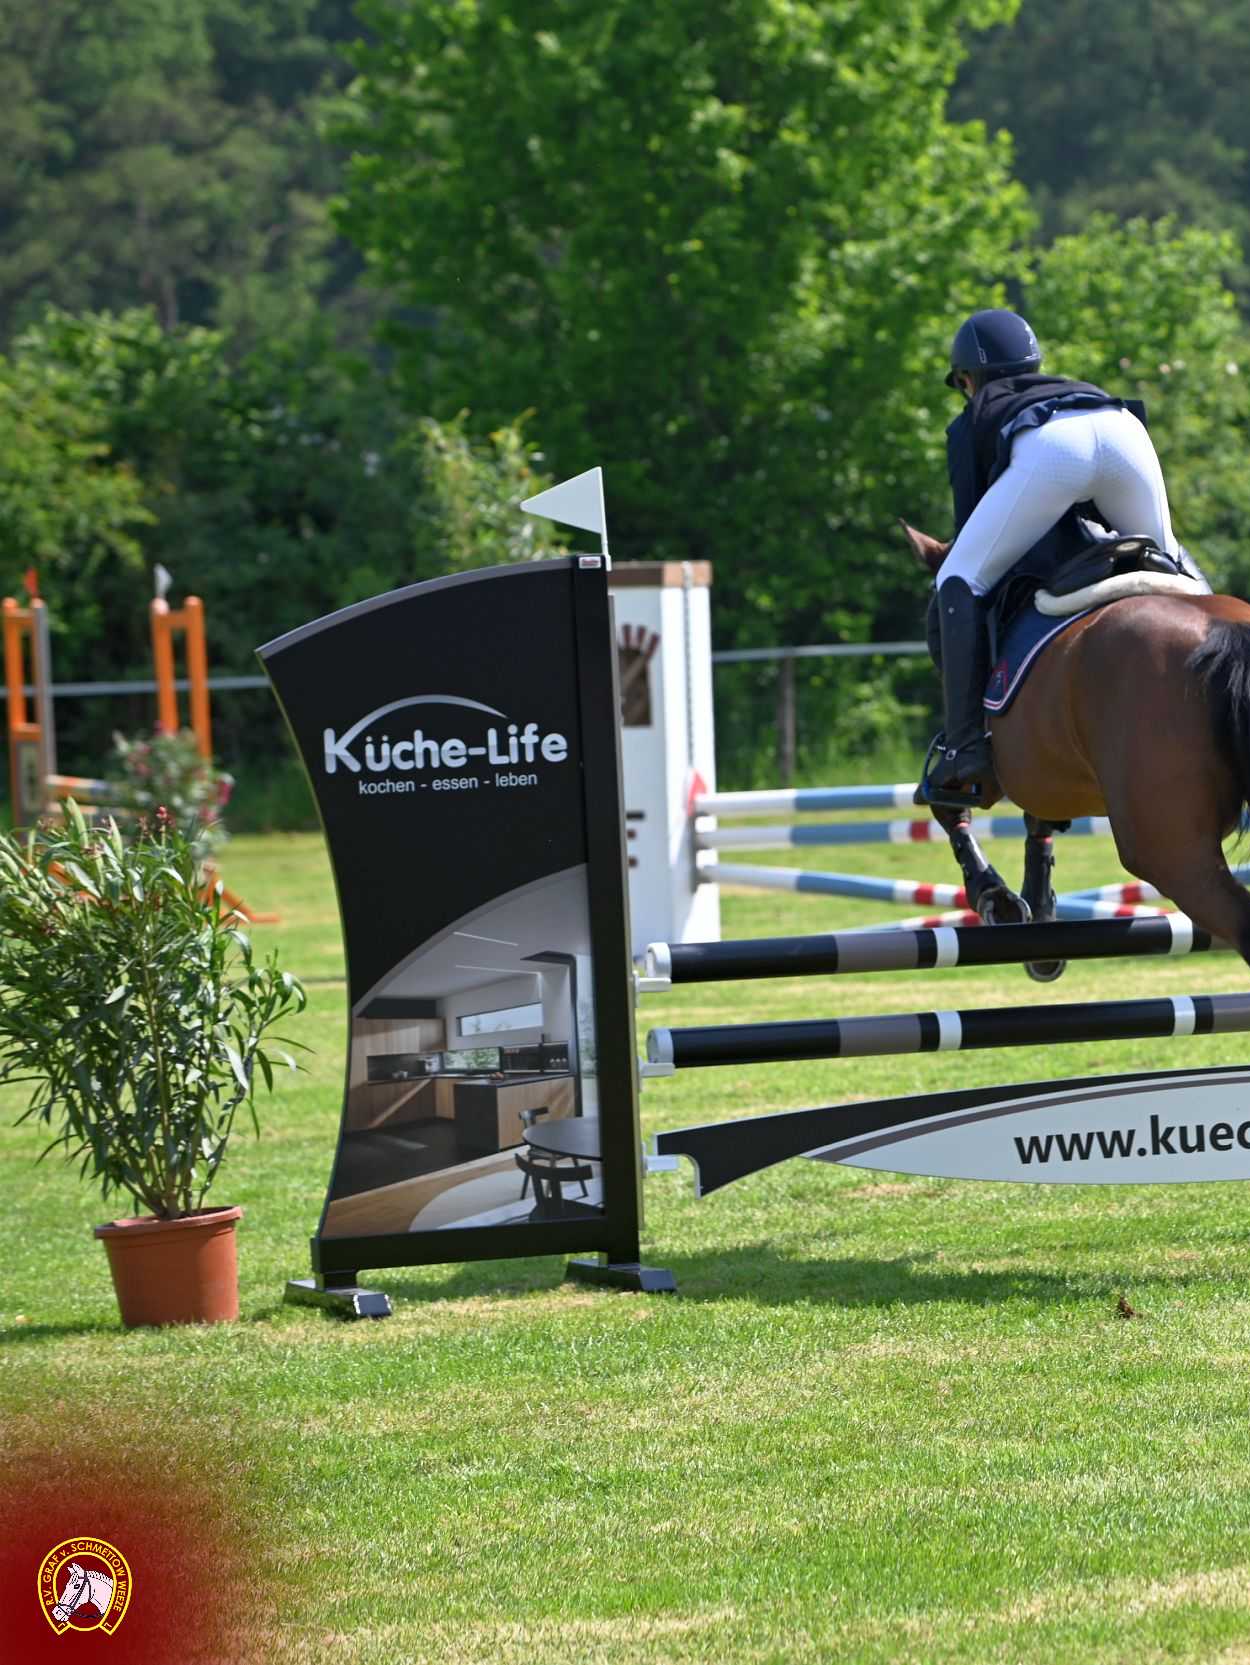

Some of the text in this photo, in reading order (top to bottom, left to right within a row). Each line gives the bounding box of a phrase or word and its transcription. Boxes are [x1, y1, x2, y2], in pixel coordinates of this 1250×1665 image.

[323, 723, 568, 774] Küche-Life
[358, 778, 415, 795] kochen
[432, 776, 478, 791] essen
[495, 772, 538, 788] leben
